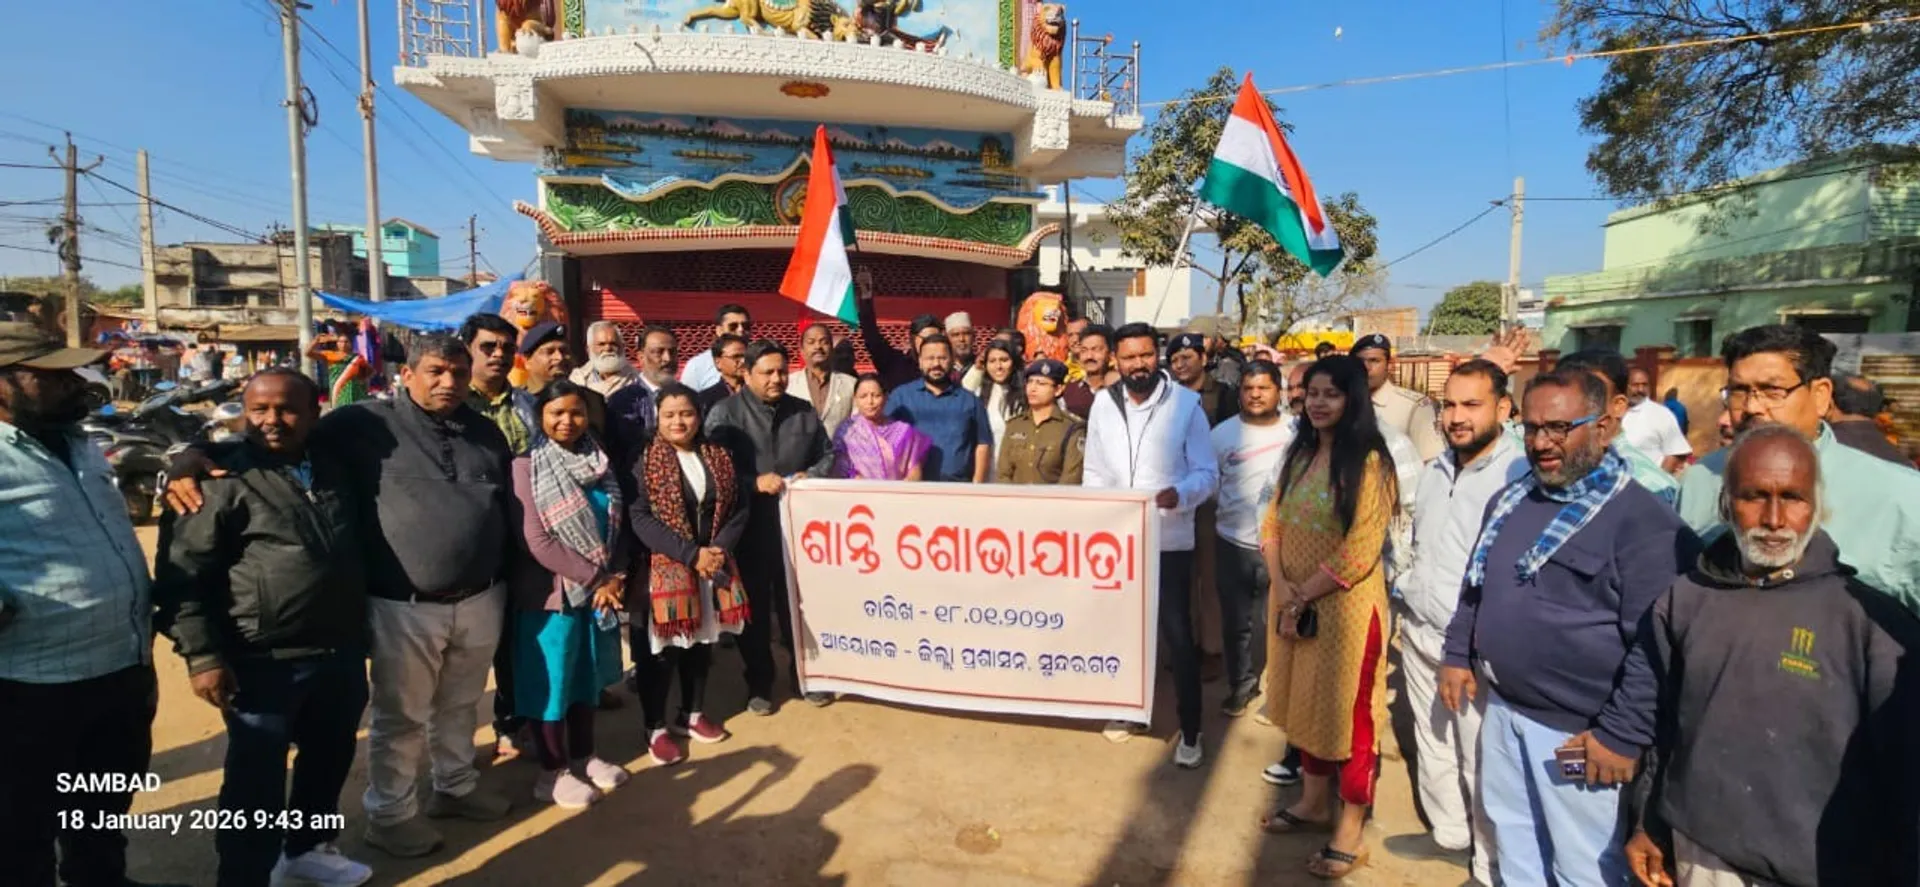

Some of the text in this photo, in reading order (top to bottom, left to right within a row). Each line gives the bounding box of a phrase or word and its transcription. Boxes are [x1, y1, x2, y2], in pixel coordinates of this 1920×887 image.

[801, 504, 1136, 590] ଶାନ୍ତି ଶୋଭାଯାତ୍ରା
[863, 594, 914, 621] ତାରିଖ
[934, 605, 1065, 630] ୧୮.୦୧.୨୦୨୬
[820, 632, 897, 659] ଆୟୋଜକ
[917, 638, 954, 670] ଜିଲ୍ଲା
